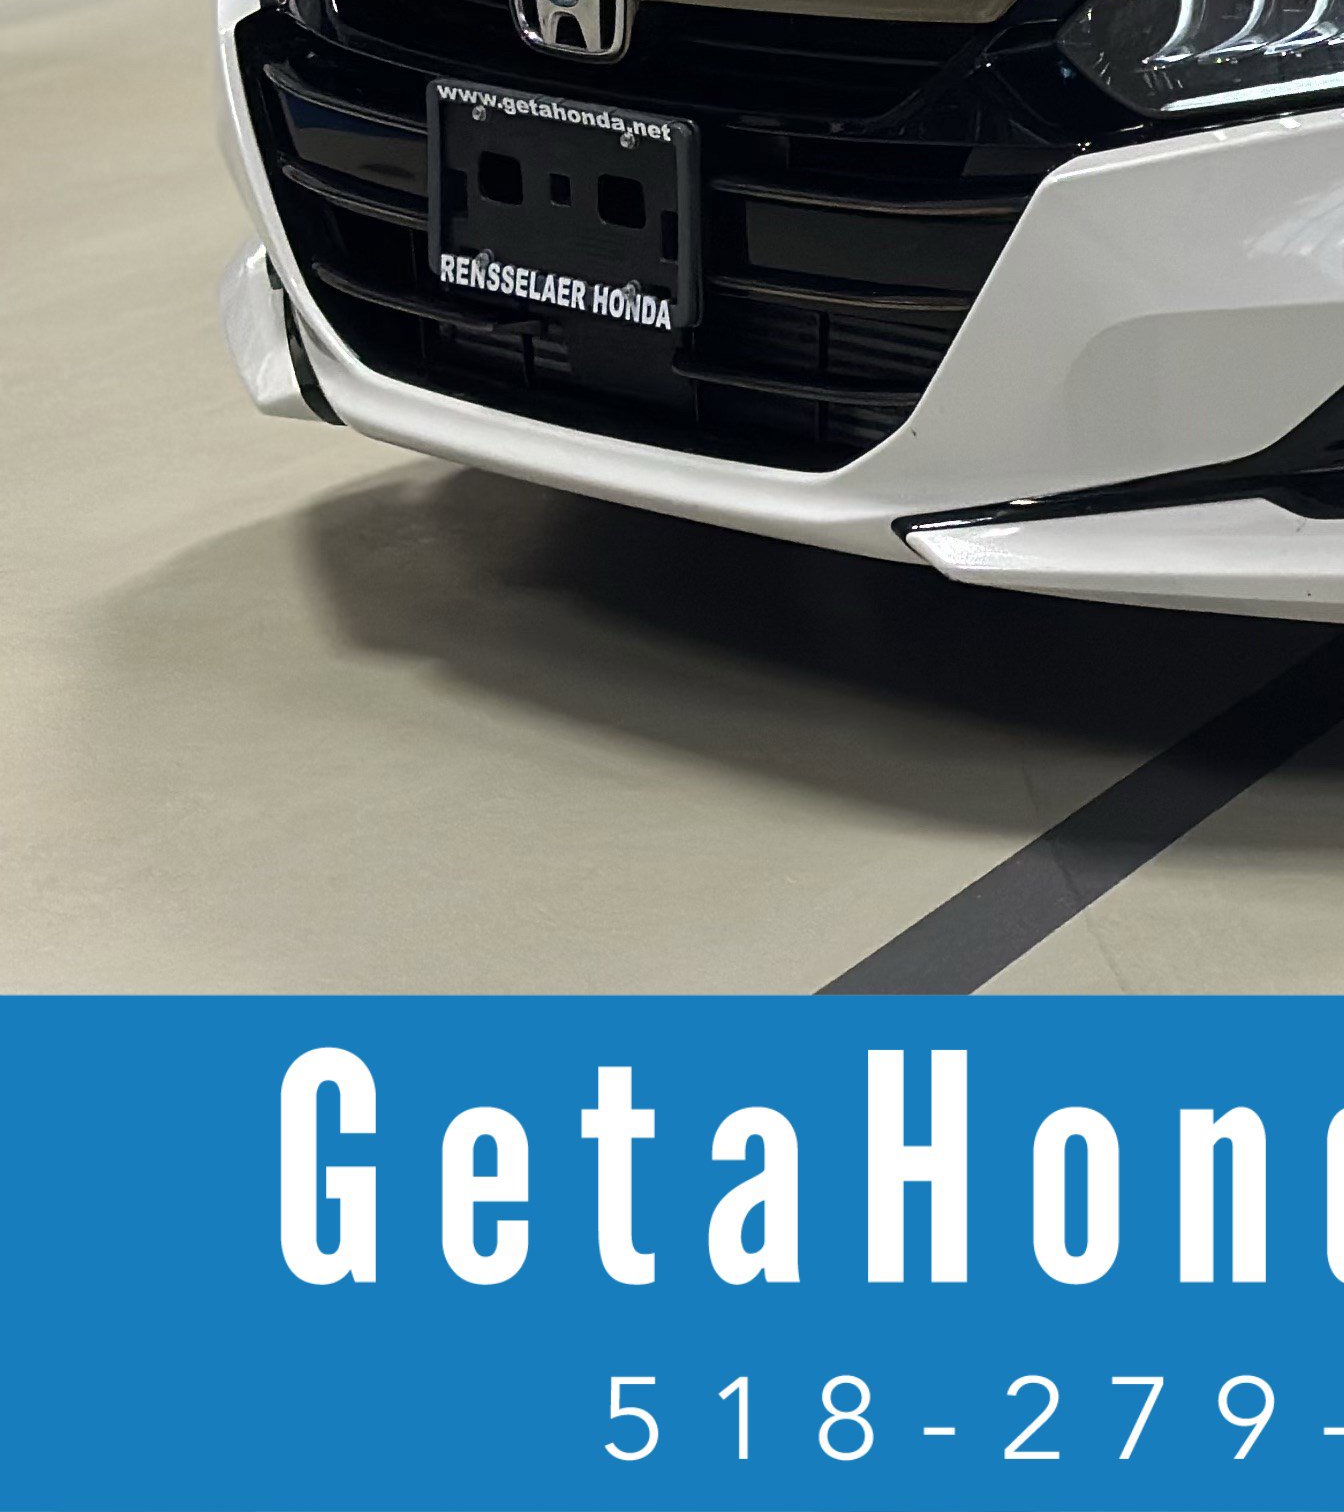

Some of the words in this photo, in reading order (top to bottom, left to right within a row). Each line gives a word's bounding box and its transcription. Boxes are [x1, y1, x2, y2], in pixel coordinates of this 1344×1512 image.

[437, 85, 671, 141] www.getahonda.net
[440, 253, 585, 311] RENSSELAER
[593, 284, 671, 330] HONDA
